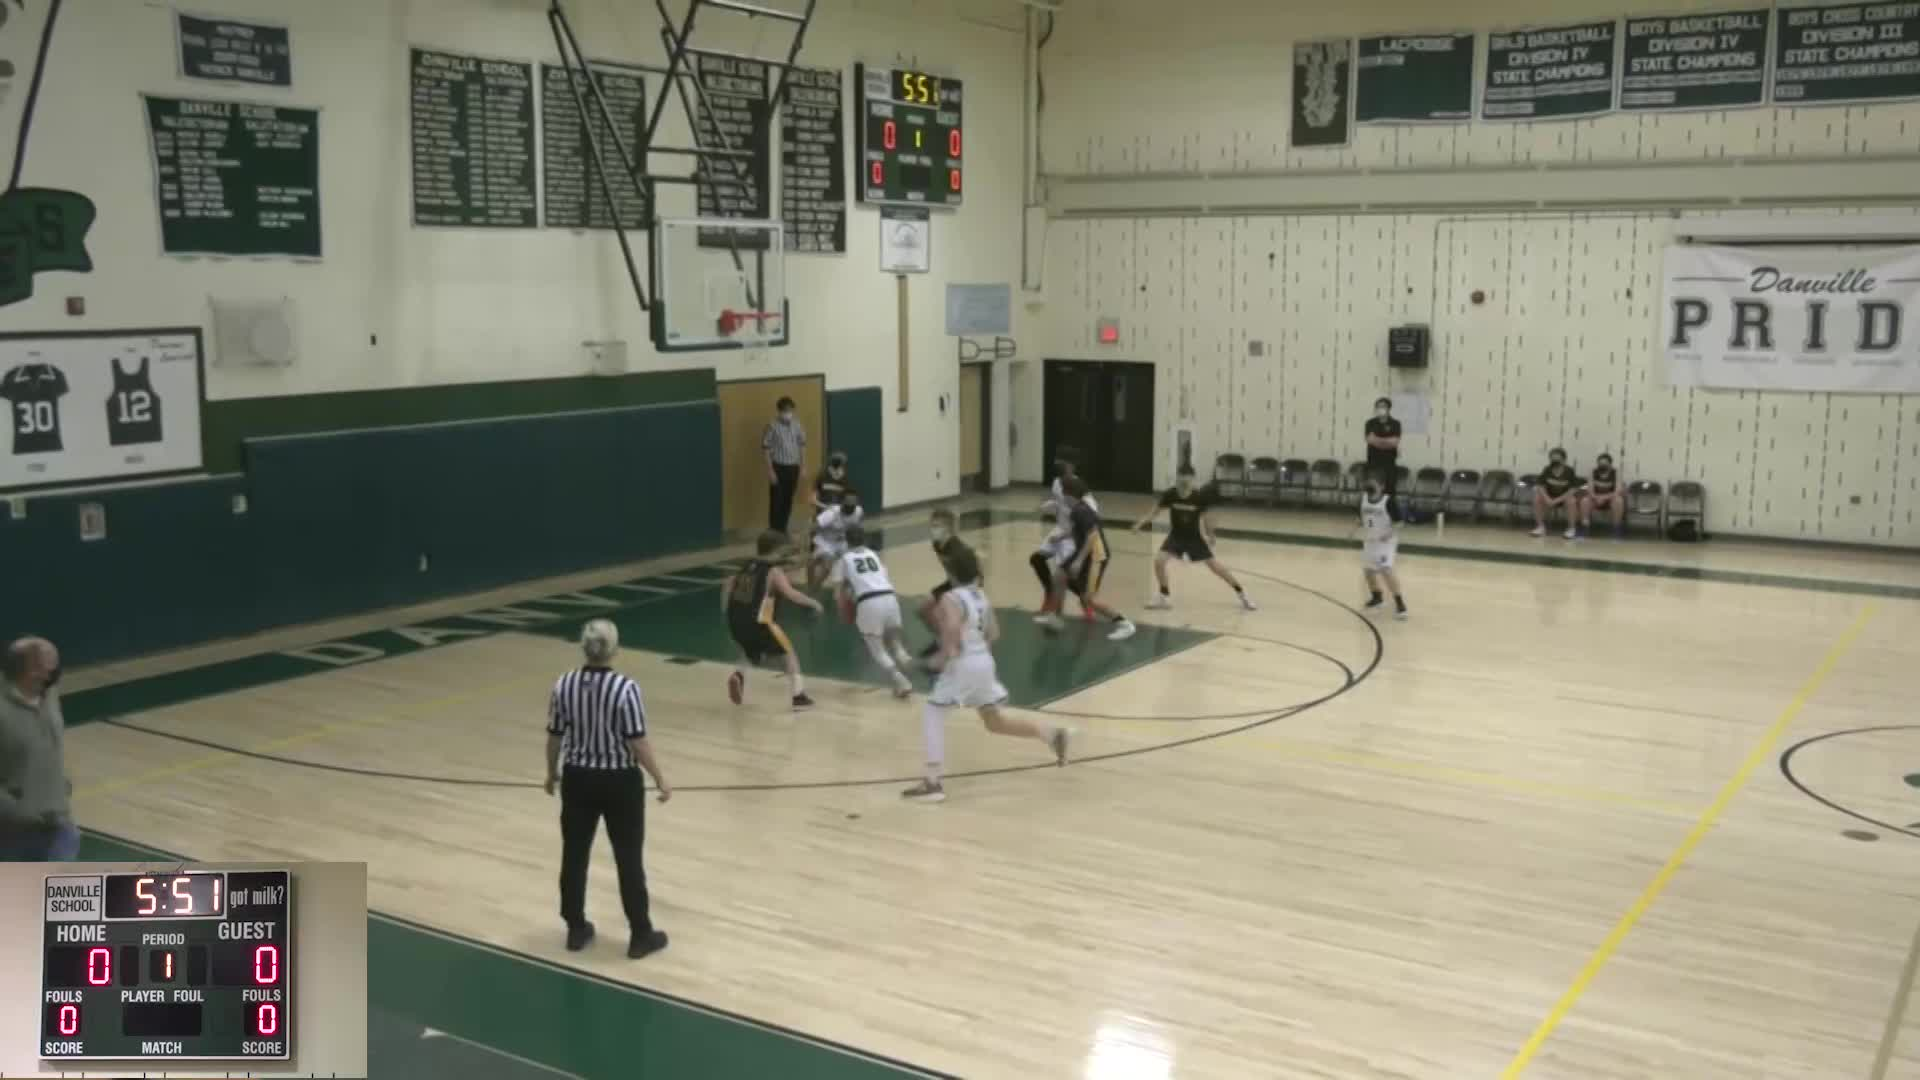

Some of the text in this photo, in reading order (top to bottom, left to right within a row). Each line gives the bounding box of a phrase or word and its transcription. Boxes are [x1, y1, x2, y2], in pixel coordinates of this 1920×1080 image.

[1528, 26, 1611, 48] BASKETBALL
[1629, 15, 1761, 36] BOYS BASKETBALL
[1802, 23, 1904, 44] DIVISION III
[1648, 33, 1740, 53] DIVISION IV
[1784, 40, 1919, 64] STATE CHAMPIONS
[1507, 48, 1569, 67] DIVISION
[1631, 51, 1756, 72] STATE CHAMPIONS
[1492, 69, 1531, 85] STATE
[1534, 61, 1606, 82] CHAMPIONS
[884, 120, 961, 157] 0 1 0
[872, 161, 961, 190] 0 0
[1750, 266, 1877, 294] Danville
[17, 401, 55, 434] 30
[118, 391, 151, 423] 12
[854, 556, 880, 573] 20
